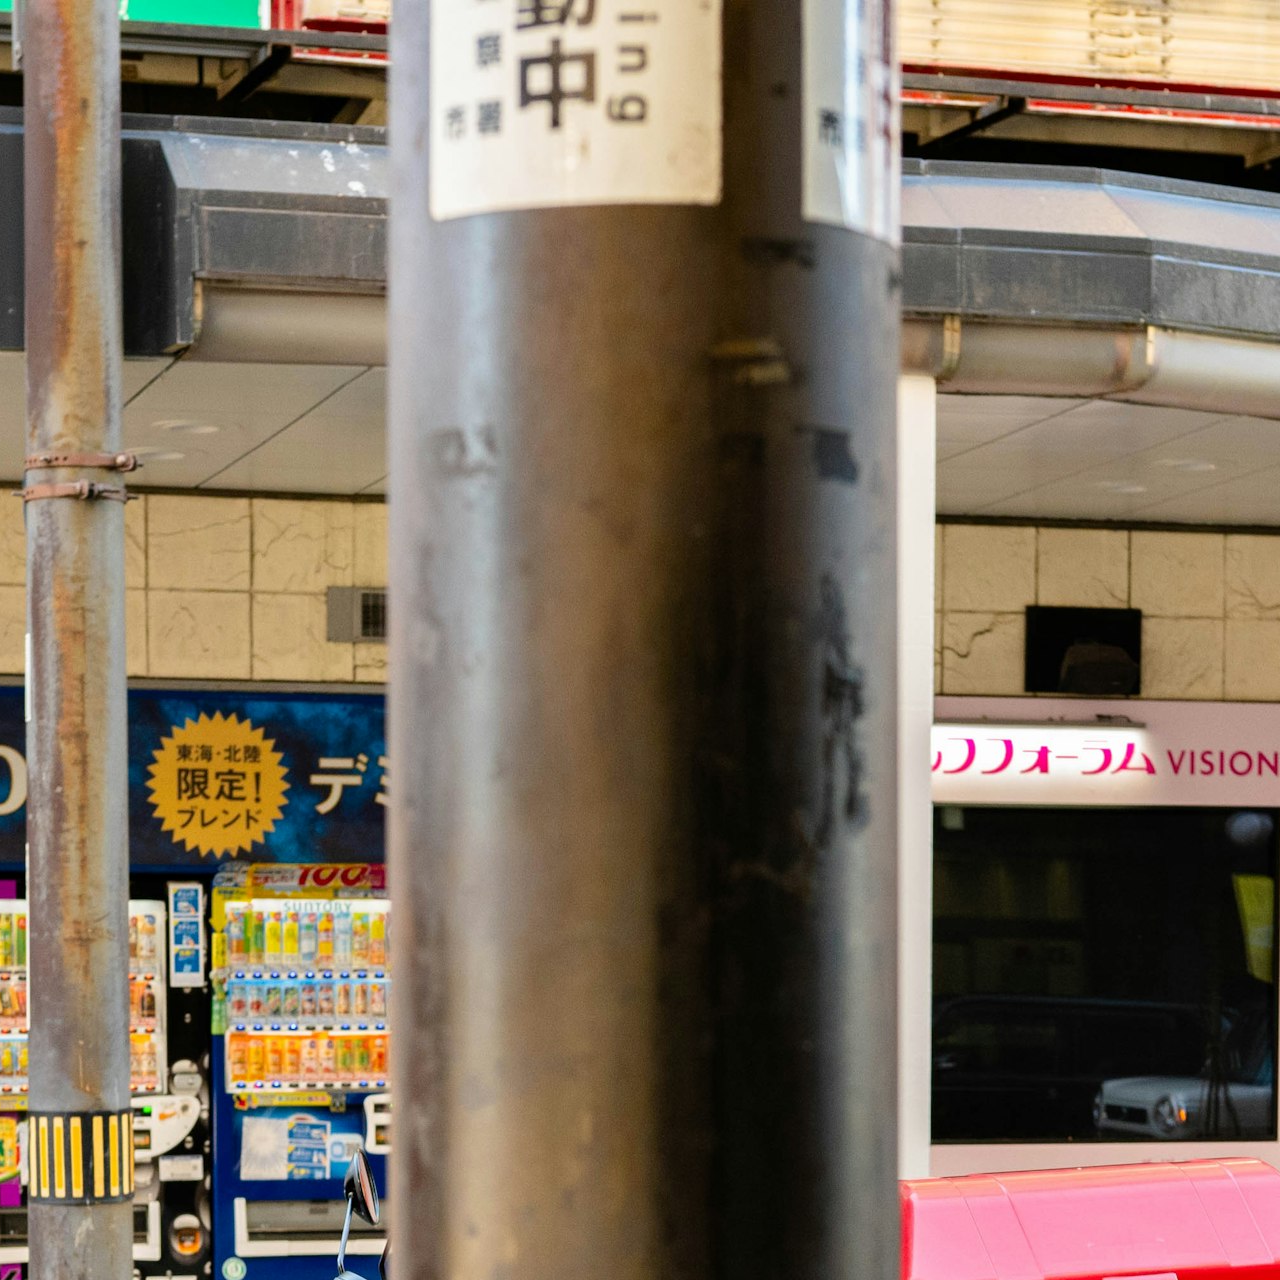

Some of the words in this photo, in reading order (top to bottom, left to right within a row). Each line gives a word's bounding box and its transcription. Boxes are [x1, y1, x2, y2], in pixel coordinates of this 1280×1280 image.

[176, 744, 261, 763] 東海・北陸
[1167, 749, 1279, 776] VISION
[177, 806, 262, 829] ブレンド
[283, 901, 353, 913] SUNTORY
